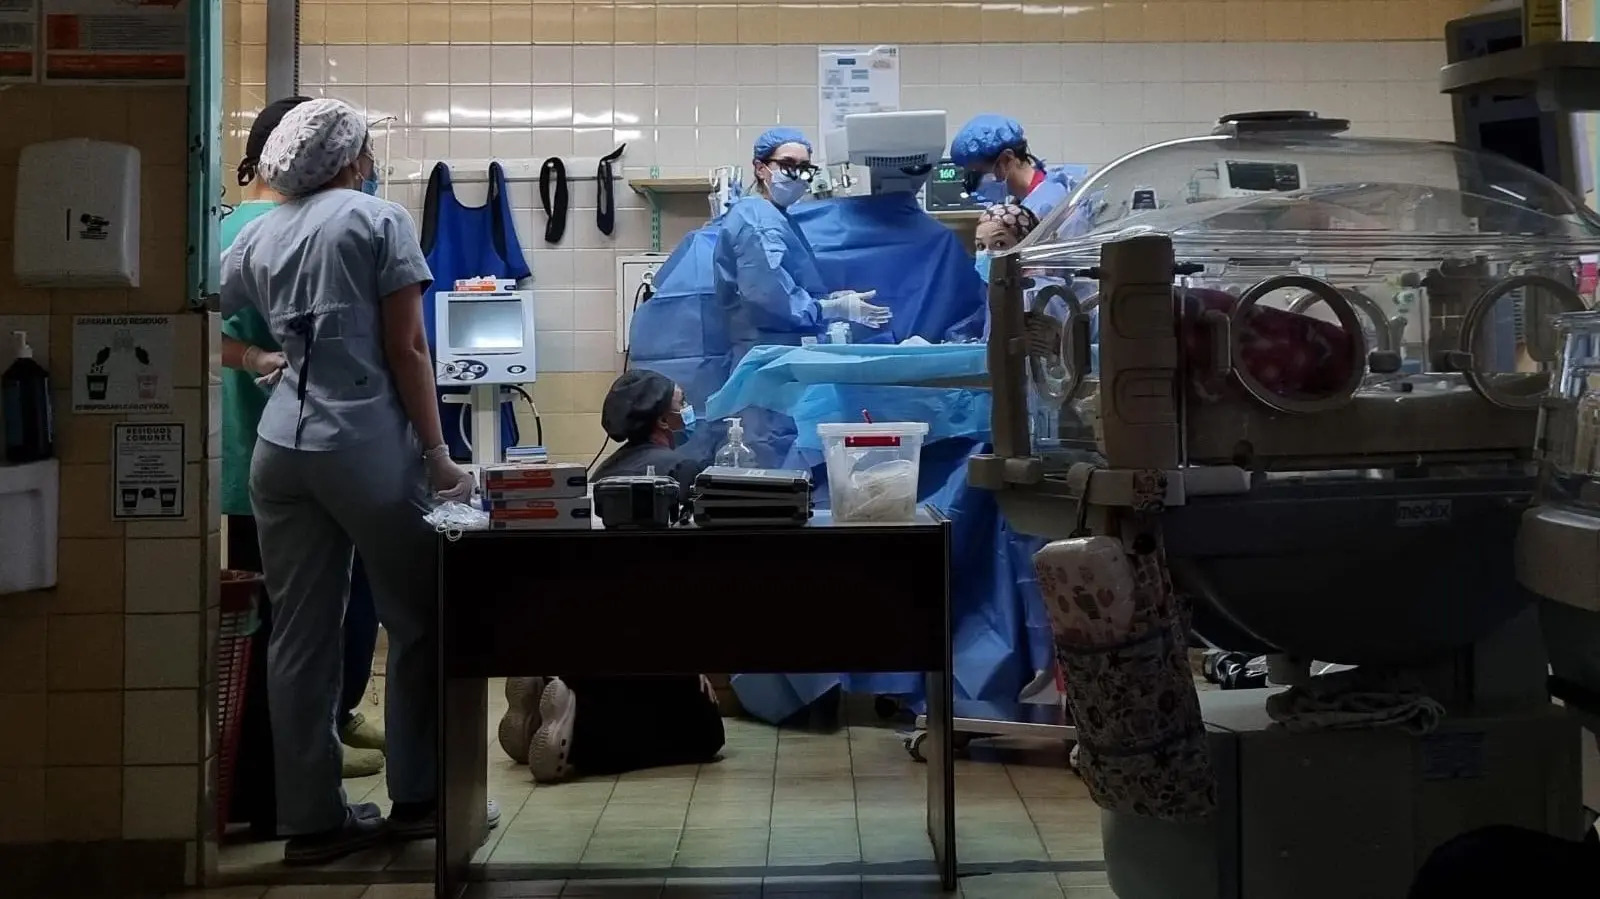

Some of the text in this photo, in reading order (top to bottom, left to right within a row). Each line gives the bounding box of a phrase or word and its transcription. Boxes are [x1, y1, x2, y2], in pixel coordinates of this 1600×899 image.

[939, 169, 955, 179] 160
[113, 317, 127, 326] LOS
[126, 434, 172, 442] COMUNES
[1398, 501, 1449, 519] medix
